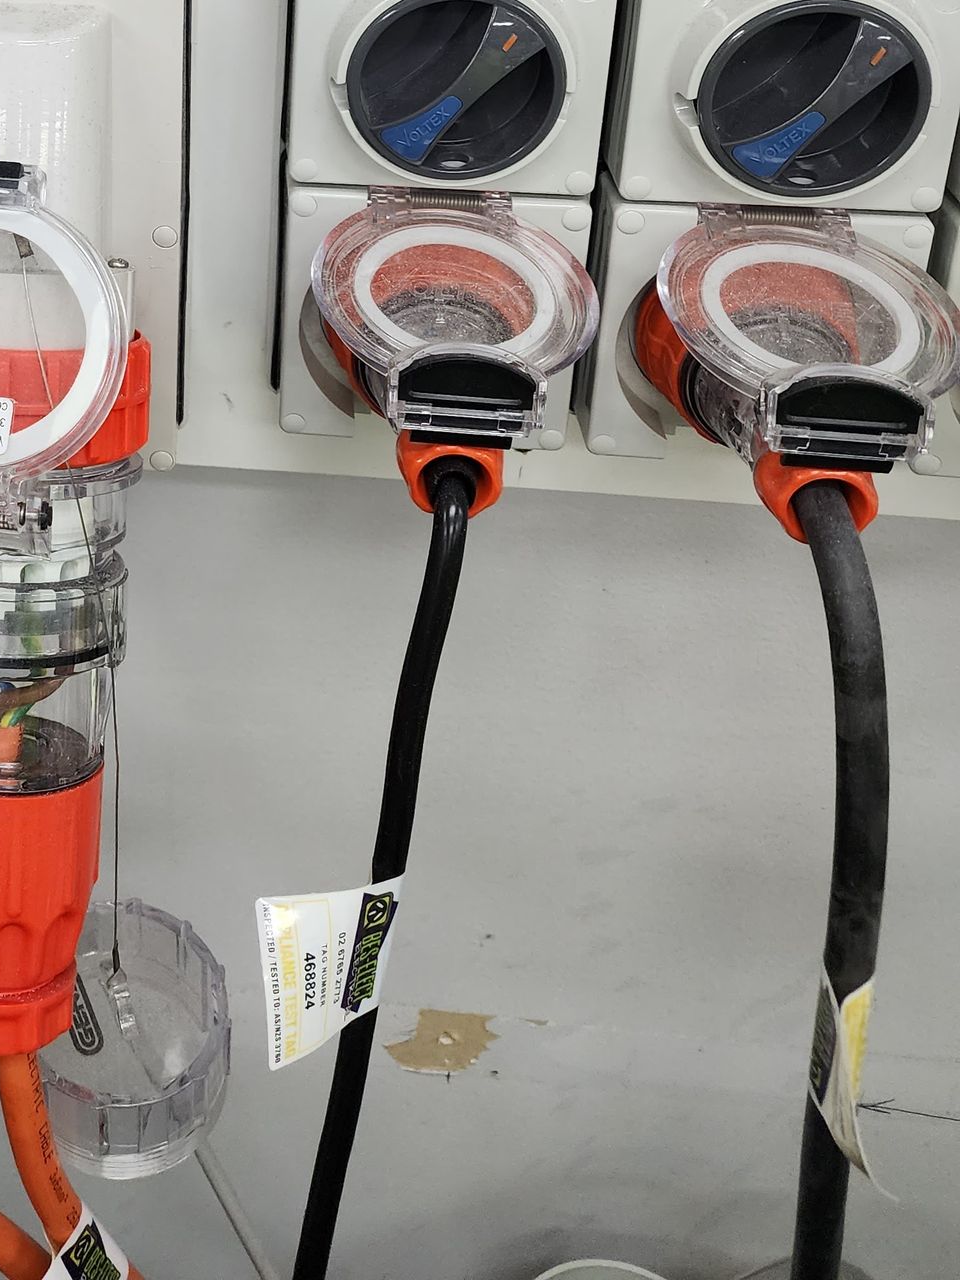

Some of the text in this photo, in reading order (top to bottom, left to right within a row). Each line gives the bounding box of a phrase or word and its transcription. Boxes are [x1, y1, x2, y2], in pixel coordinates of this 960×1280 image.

[396, 106, 450, 146] VOLTEX
[750, 122, 811, 163] VOLTEX
[338, 932, 346, 944] 02
[269, 962, 280, 994] TESTED
[304, 952, 317, 1010] 468824
